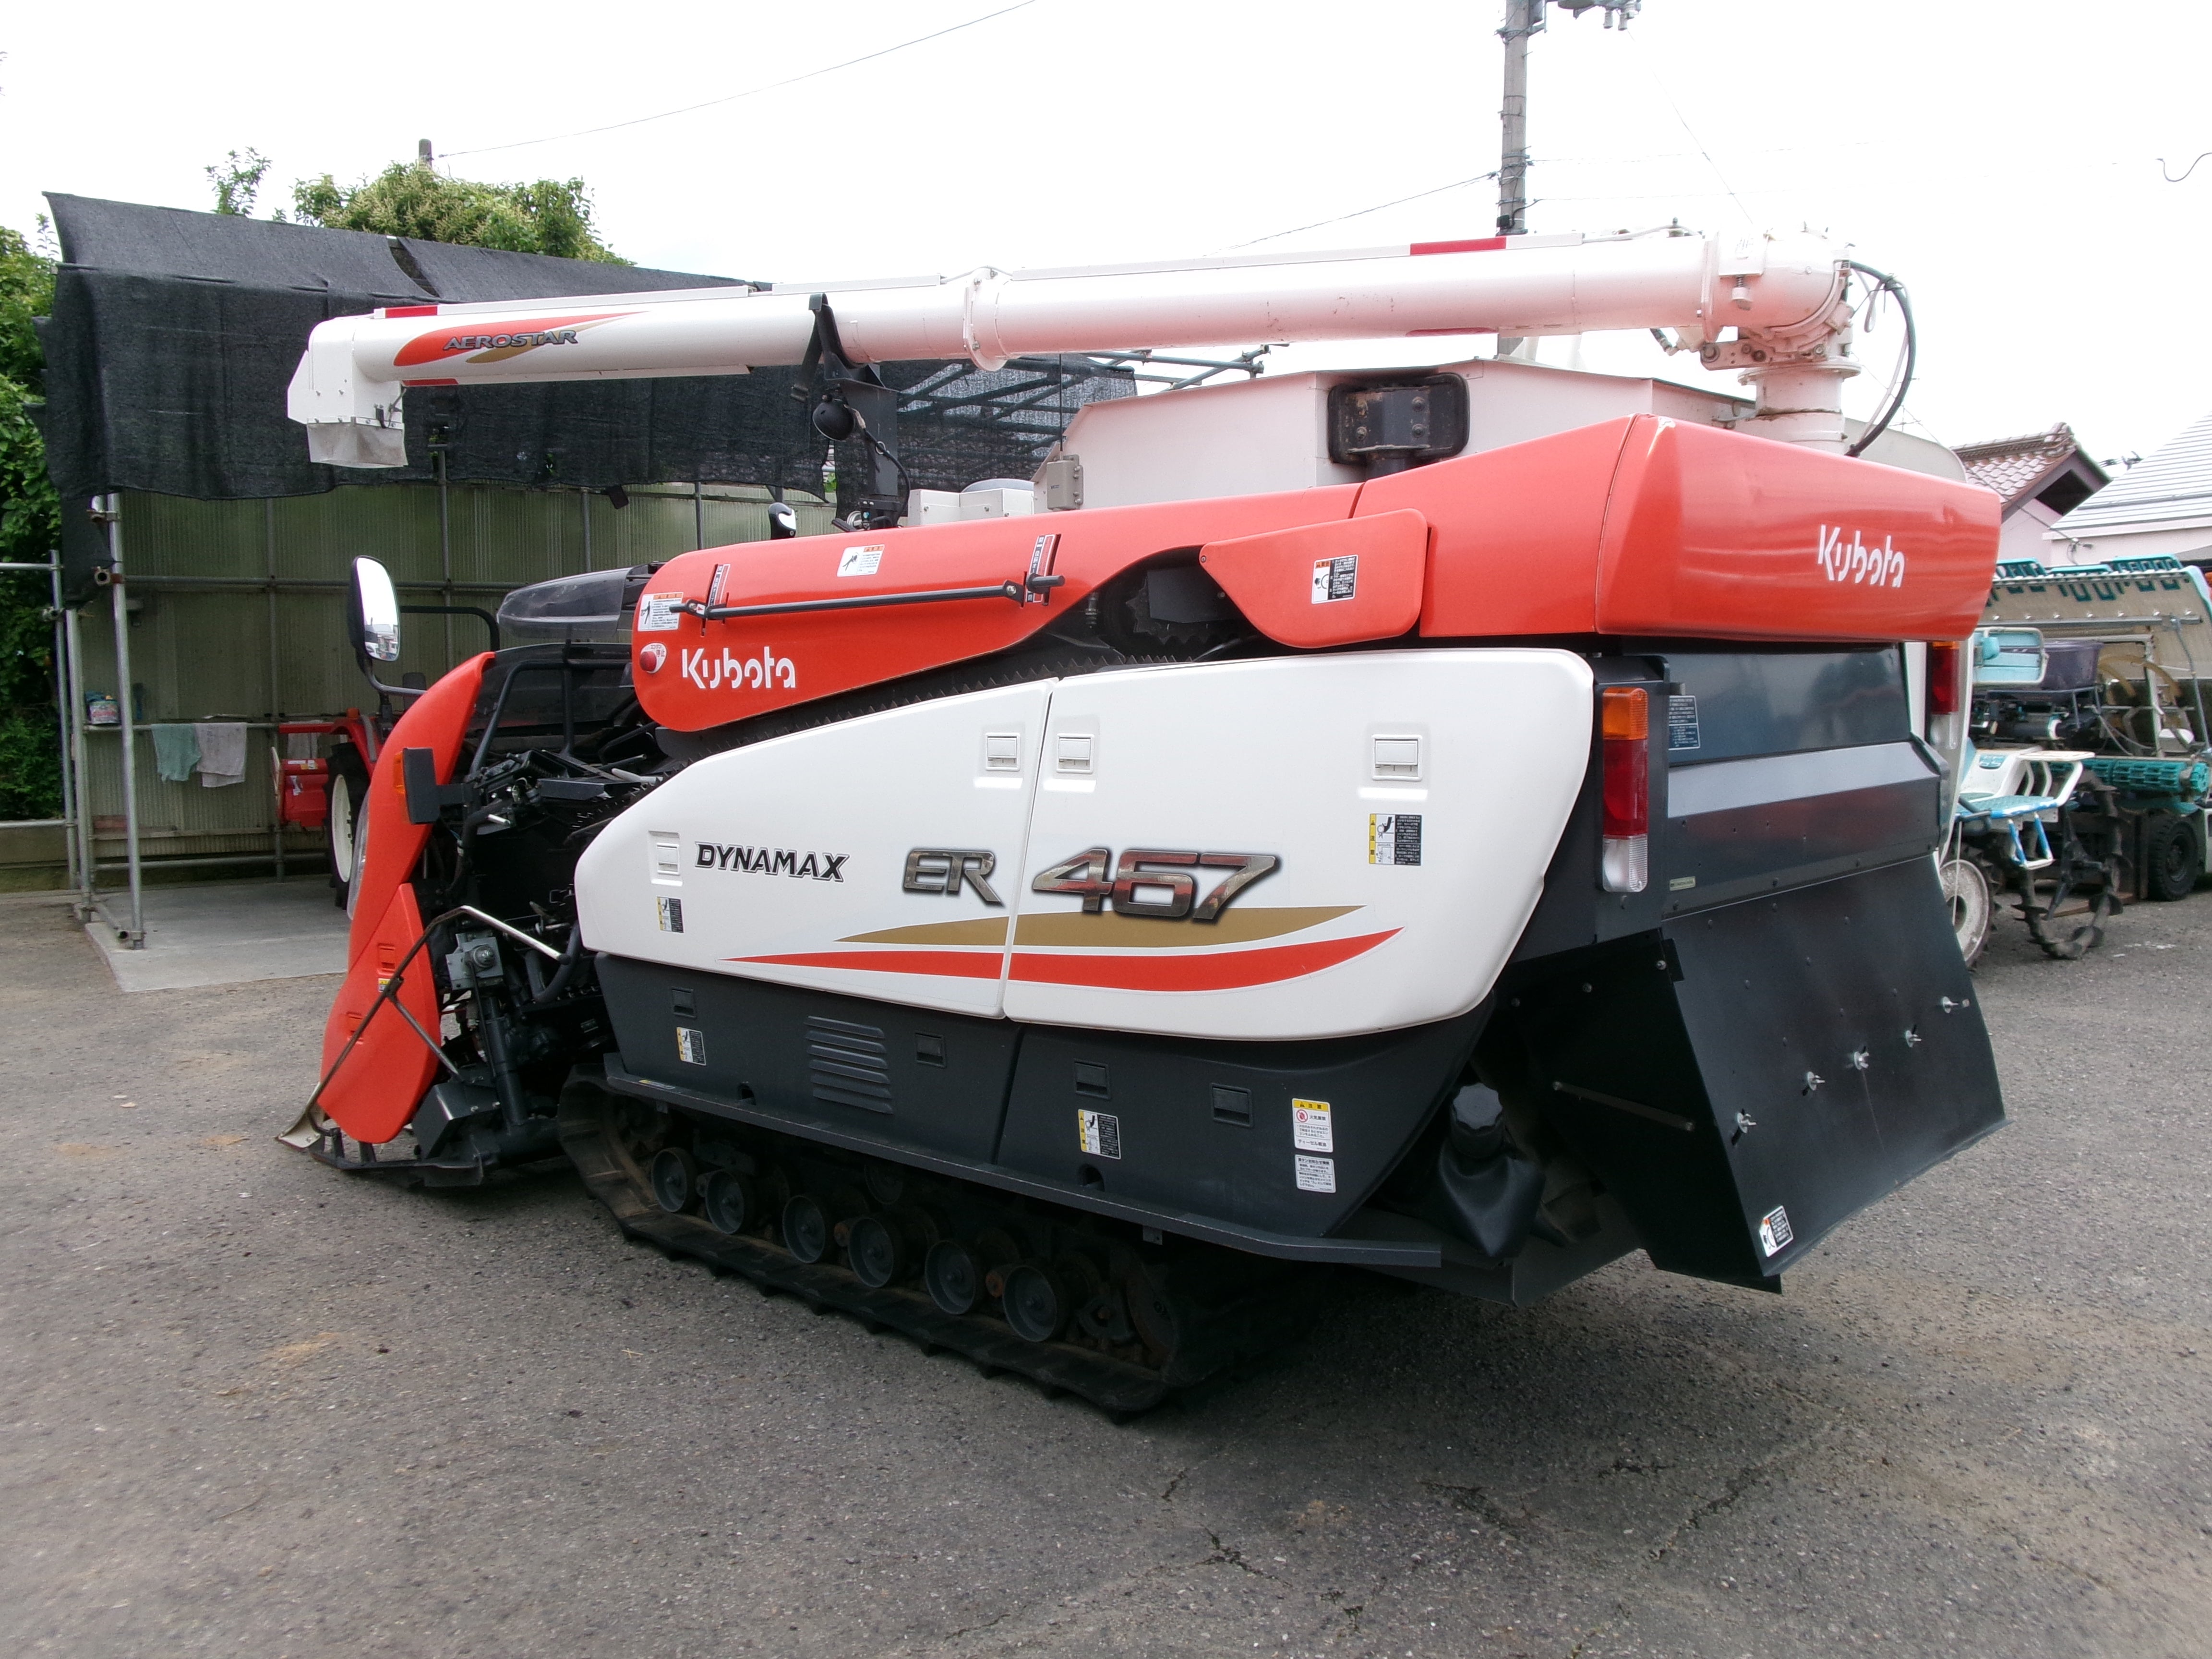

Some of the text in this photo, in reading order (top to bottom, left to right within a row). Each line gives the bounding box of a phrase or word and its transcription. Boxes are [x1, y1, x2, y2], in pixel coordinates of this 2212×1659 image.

[443, 330, 578, 350] AEROSTAR
[1818, 524, 1905, 589] Kubota
[682, 646, 796, 689] Kubota
[694, 841, 850, 882] DYNAMAX
[903, 848, 1278, 921] ER 467
